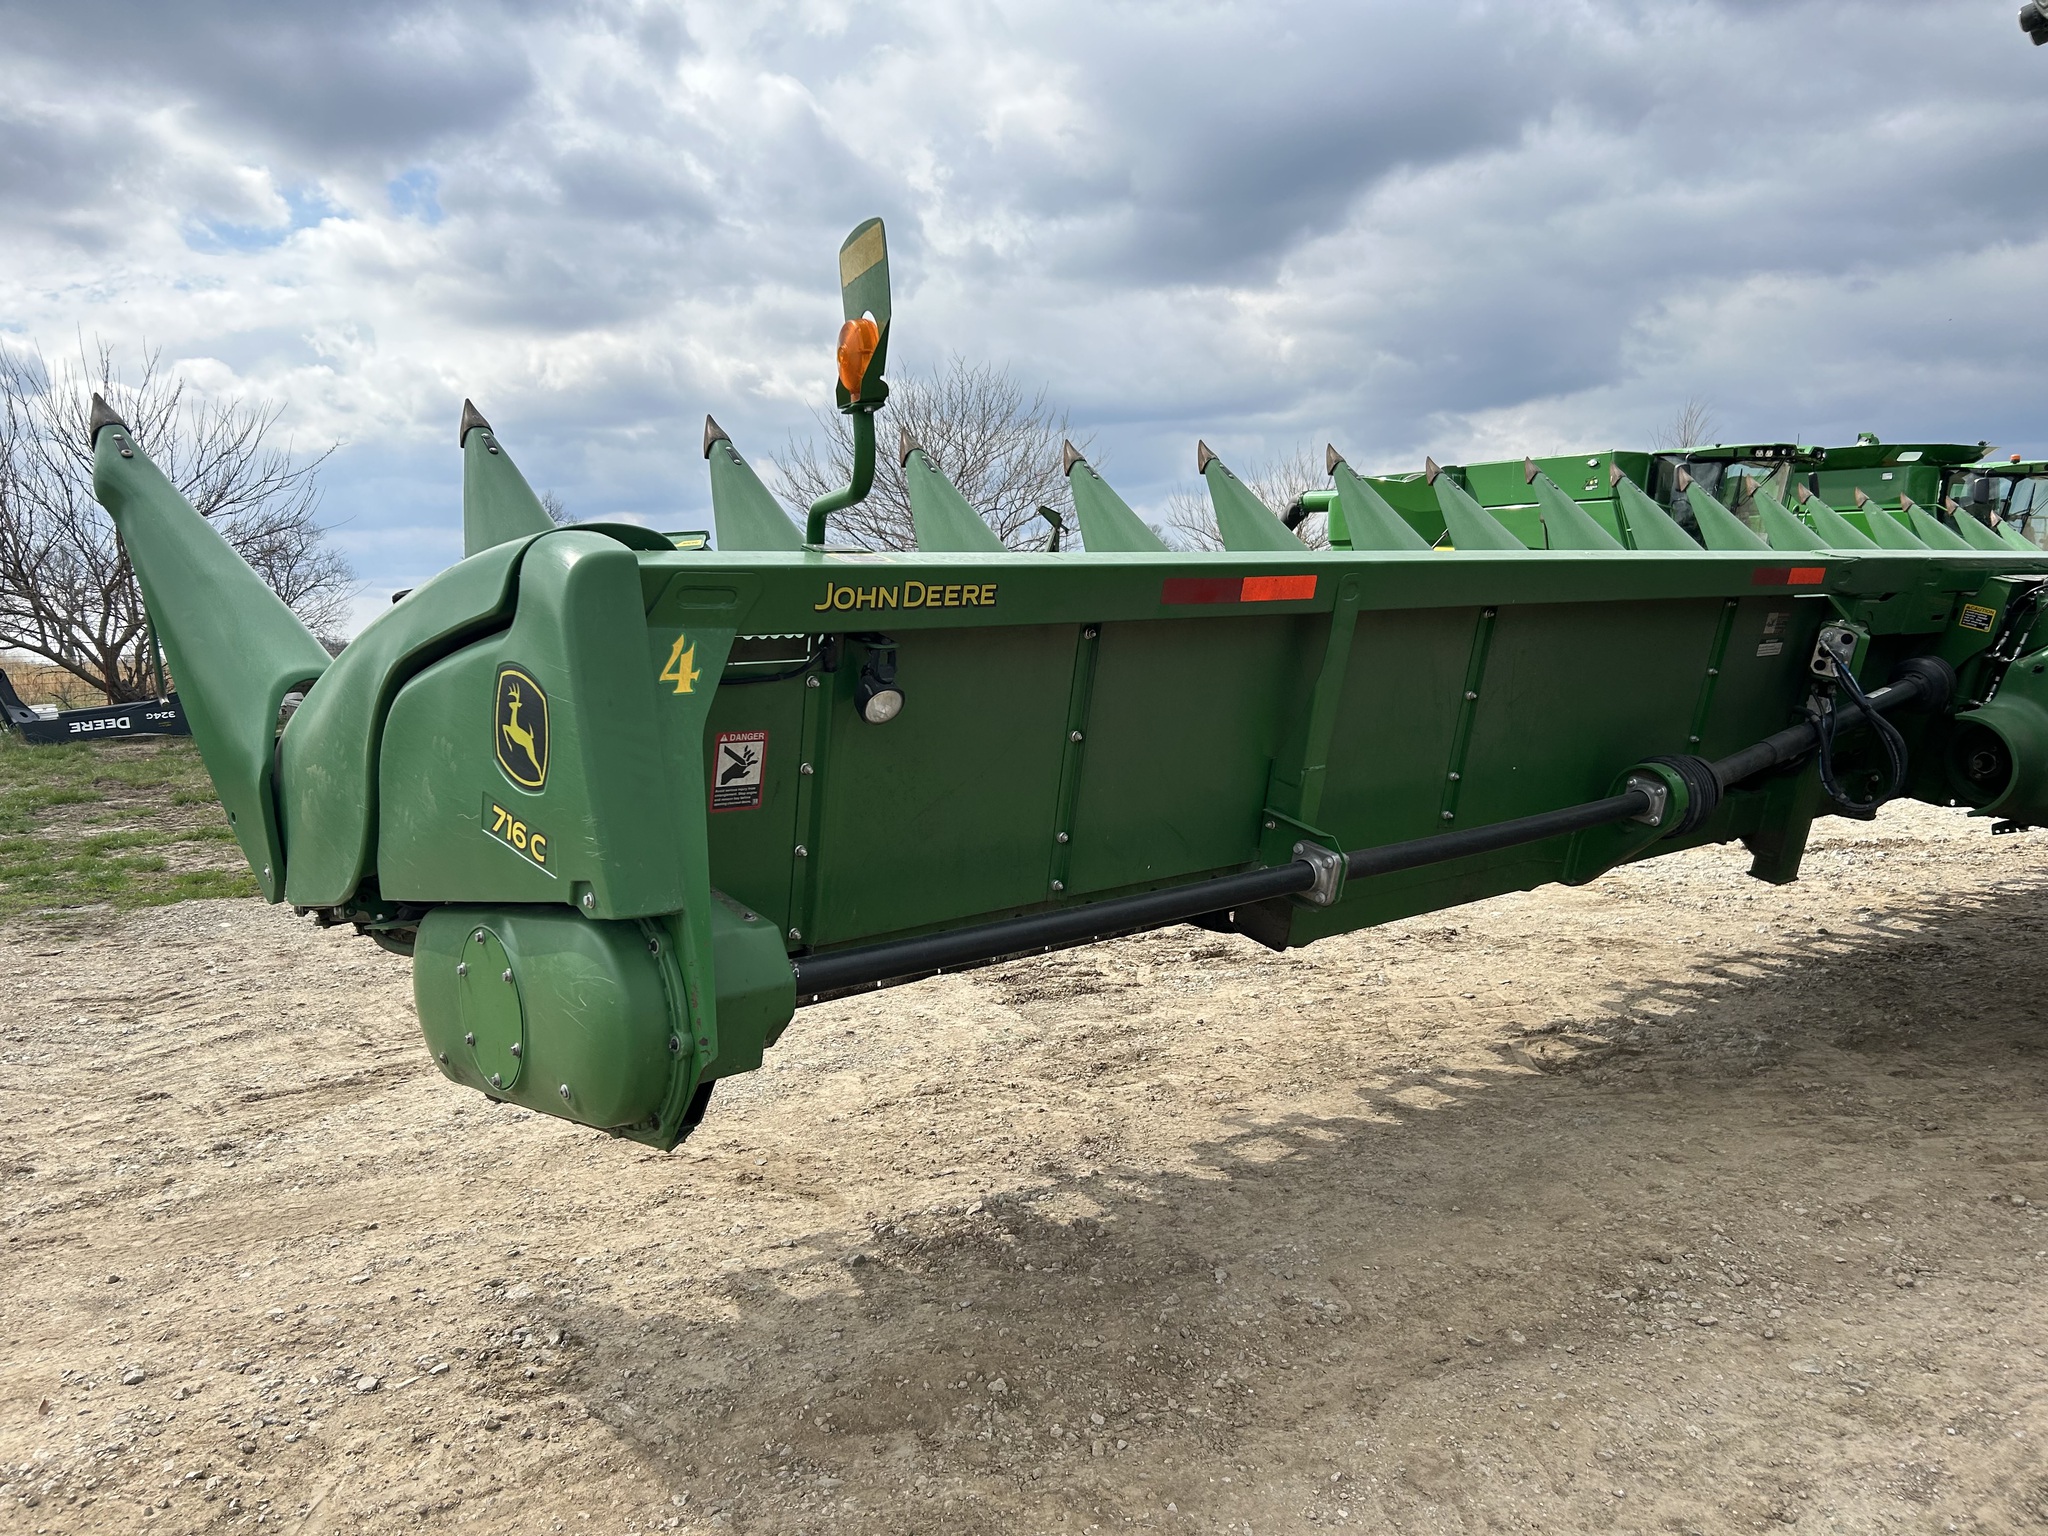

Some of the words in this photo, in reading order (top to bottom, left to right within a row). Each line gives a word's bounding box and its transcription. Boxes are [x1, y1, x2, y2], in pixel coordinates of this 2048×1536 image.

[814, 581, 899, 611] JOHN
[902, 580, 998, 608] DEERE
[1970, 605, 1995, 615] CAUTION
[659, 633, 701, 694] 4
[68, 716, 131, 733] DEERE
[729, 732, 765, 742] DANGER
